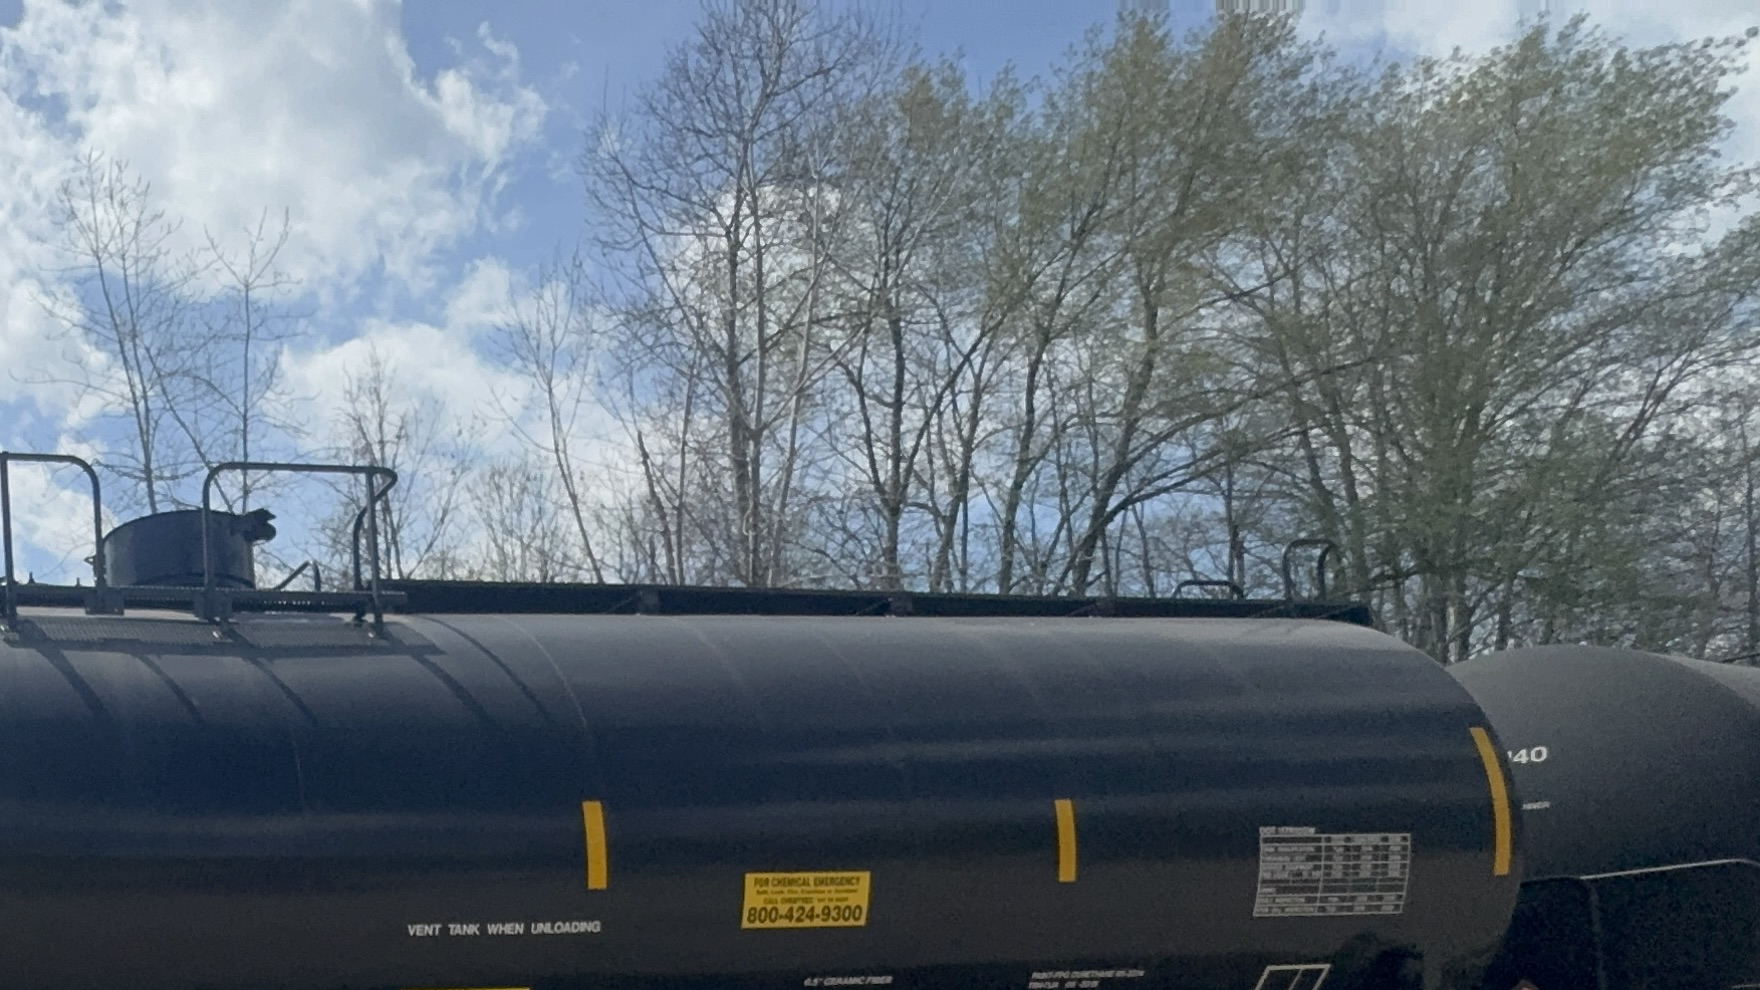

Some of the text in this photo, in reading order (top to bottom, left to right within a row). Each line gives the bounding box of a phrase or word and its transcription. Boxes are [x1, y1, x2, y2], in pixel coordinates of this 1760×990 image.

[771, 876, 811, 887] CHEMICAL
[813, 875, 861, 886] EMERGENCY
[746, 904, 863, 924] 800-424-9300
[407, 920, 601, 937] VENT TANK WHEN UNLOADING
